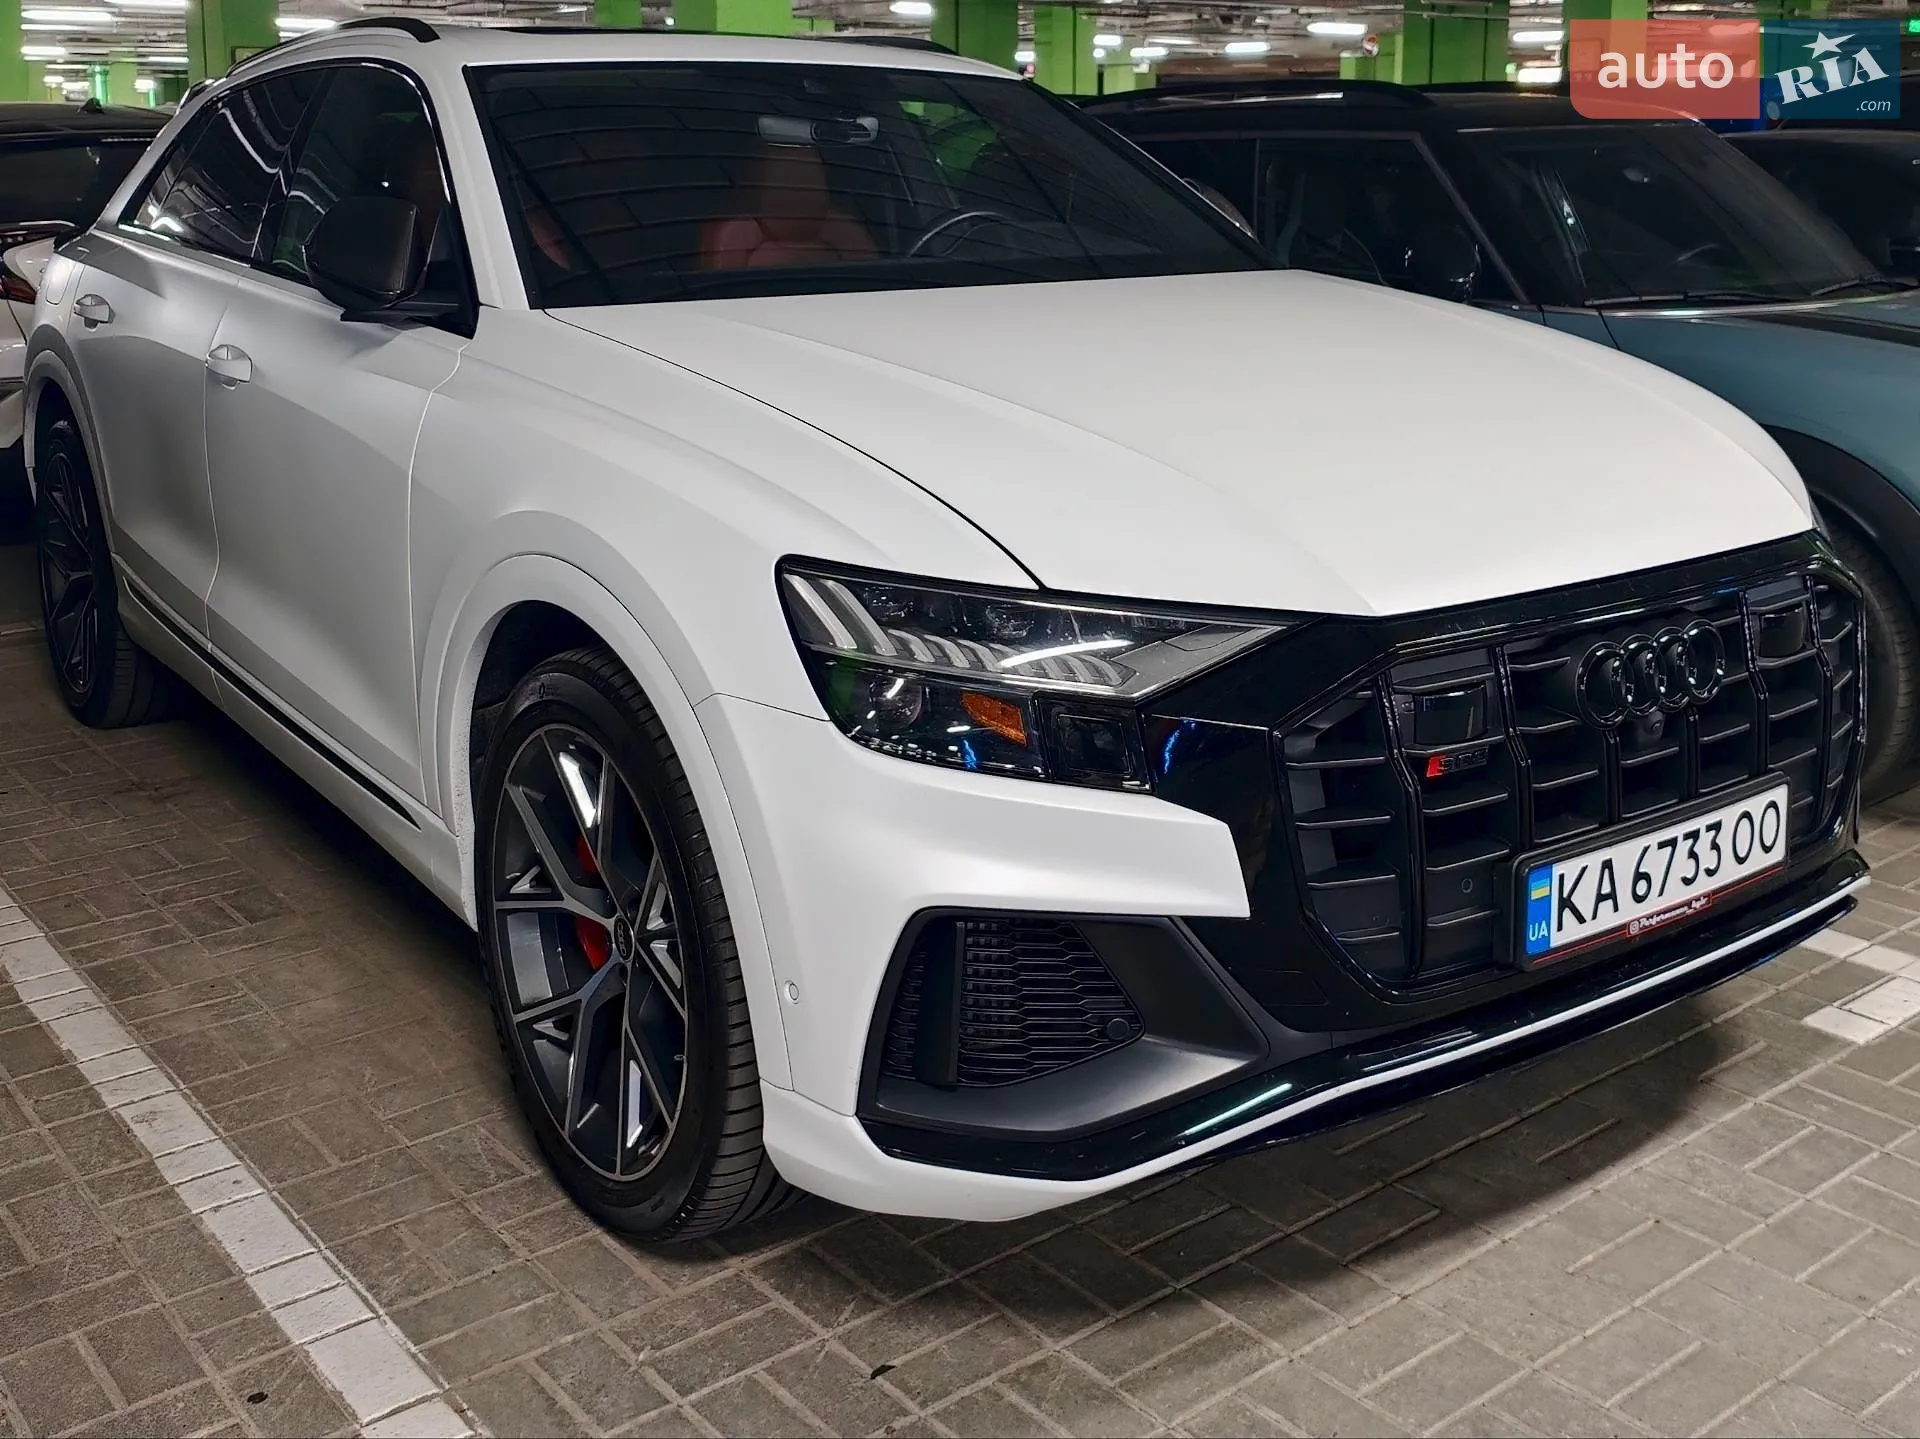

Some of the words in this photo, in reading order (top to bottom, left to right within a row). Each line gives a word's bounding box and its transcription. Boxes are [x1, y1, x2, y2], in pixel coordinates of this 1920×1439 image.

[1556, 856, 1619, 932] KA
[1631, 818, 1722, 904] 6733
[1529, 920, 1548, 941] UA
